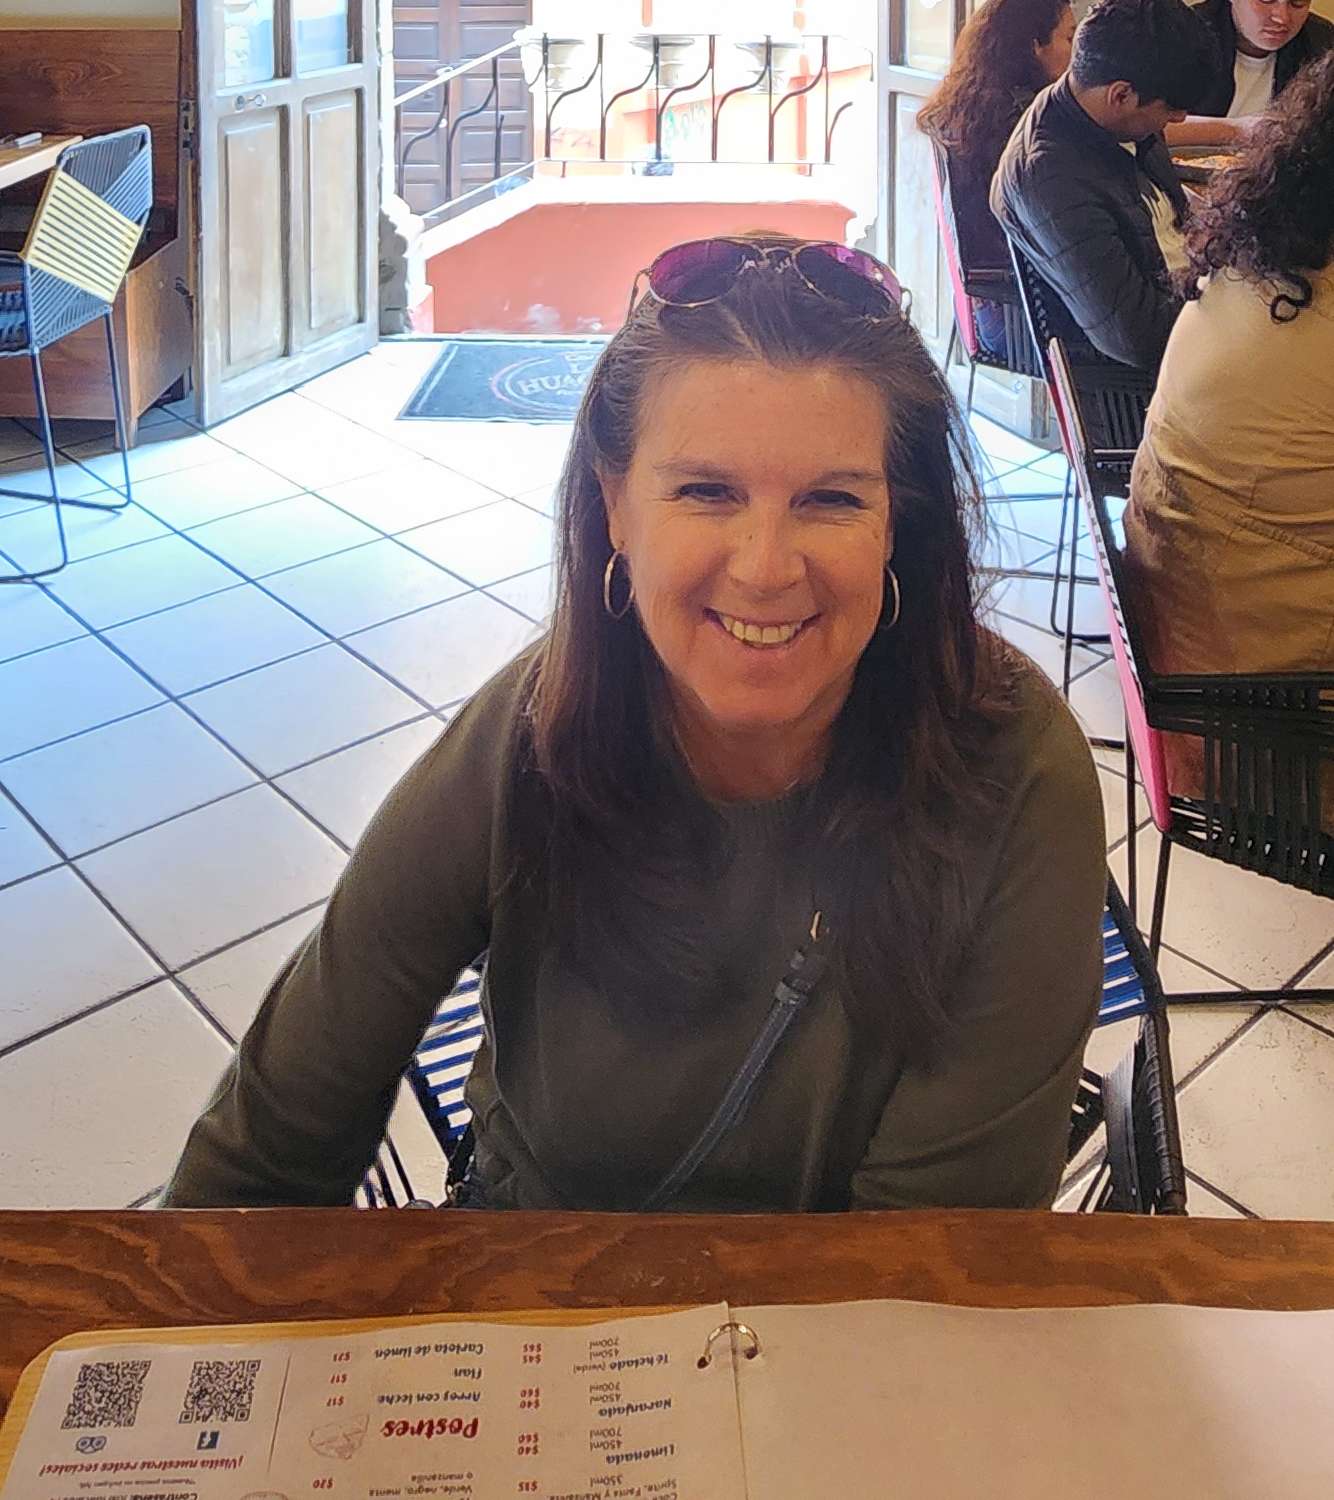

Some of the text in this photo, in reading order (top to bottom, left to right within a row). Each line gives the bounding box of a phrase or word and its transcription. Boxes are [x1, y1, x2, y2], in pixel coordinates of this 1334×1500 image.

[375, 1347, 412, 1360] limón
[415, 1345, 431, 1358] de
[433, 1343, 484, 1356] Carlota
[610, 1356, 654, 1371] helado
[377, 1394, 413, 1406] leche
[416, 1392, 440, 1404] con
[598, 1398, 672, 1418] Naranjada
[380, 1417, 479, 1440] Postres
[590, 1426, 622, 1438] 700ml
[517, 1439, 623, 1455] 450ml $40
[605, 1444, 675, 1465] Limonada
[39, 1455, 243, 1477] ¡Visita nuestras redes sociales!
[440, 1484, 472, 1494] Verde,
